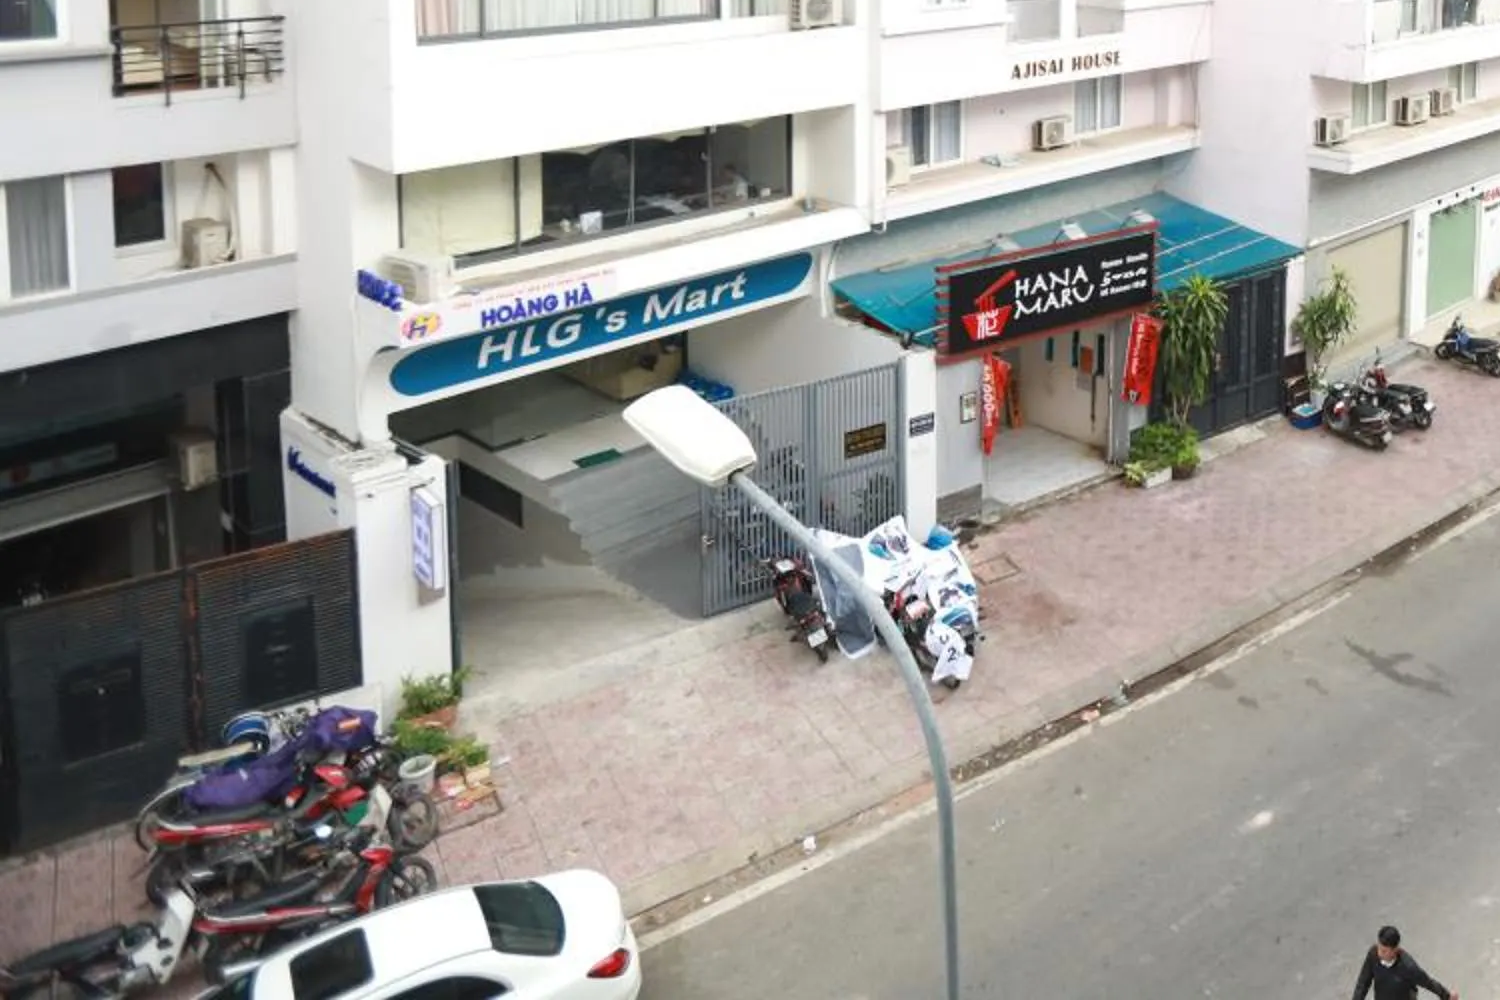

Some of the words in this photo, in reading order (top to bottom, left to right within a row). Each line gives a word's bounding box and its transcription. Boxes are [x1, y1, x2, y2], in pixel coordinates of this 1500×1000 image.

[1011, 57, 1064, 80] AJISAI
[1071, 50, 1122, 72] HOUSE
[1014, 265, 1089, 299] HANA
[476, 314, 582, 370] HLG
[642, 270, 748, 327] Mart
[480, 293, 559, 328] HOÀNG
[564, 282, 593, 309] HÀ
[1014, 283, 1097, 320] MARU
